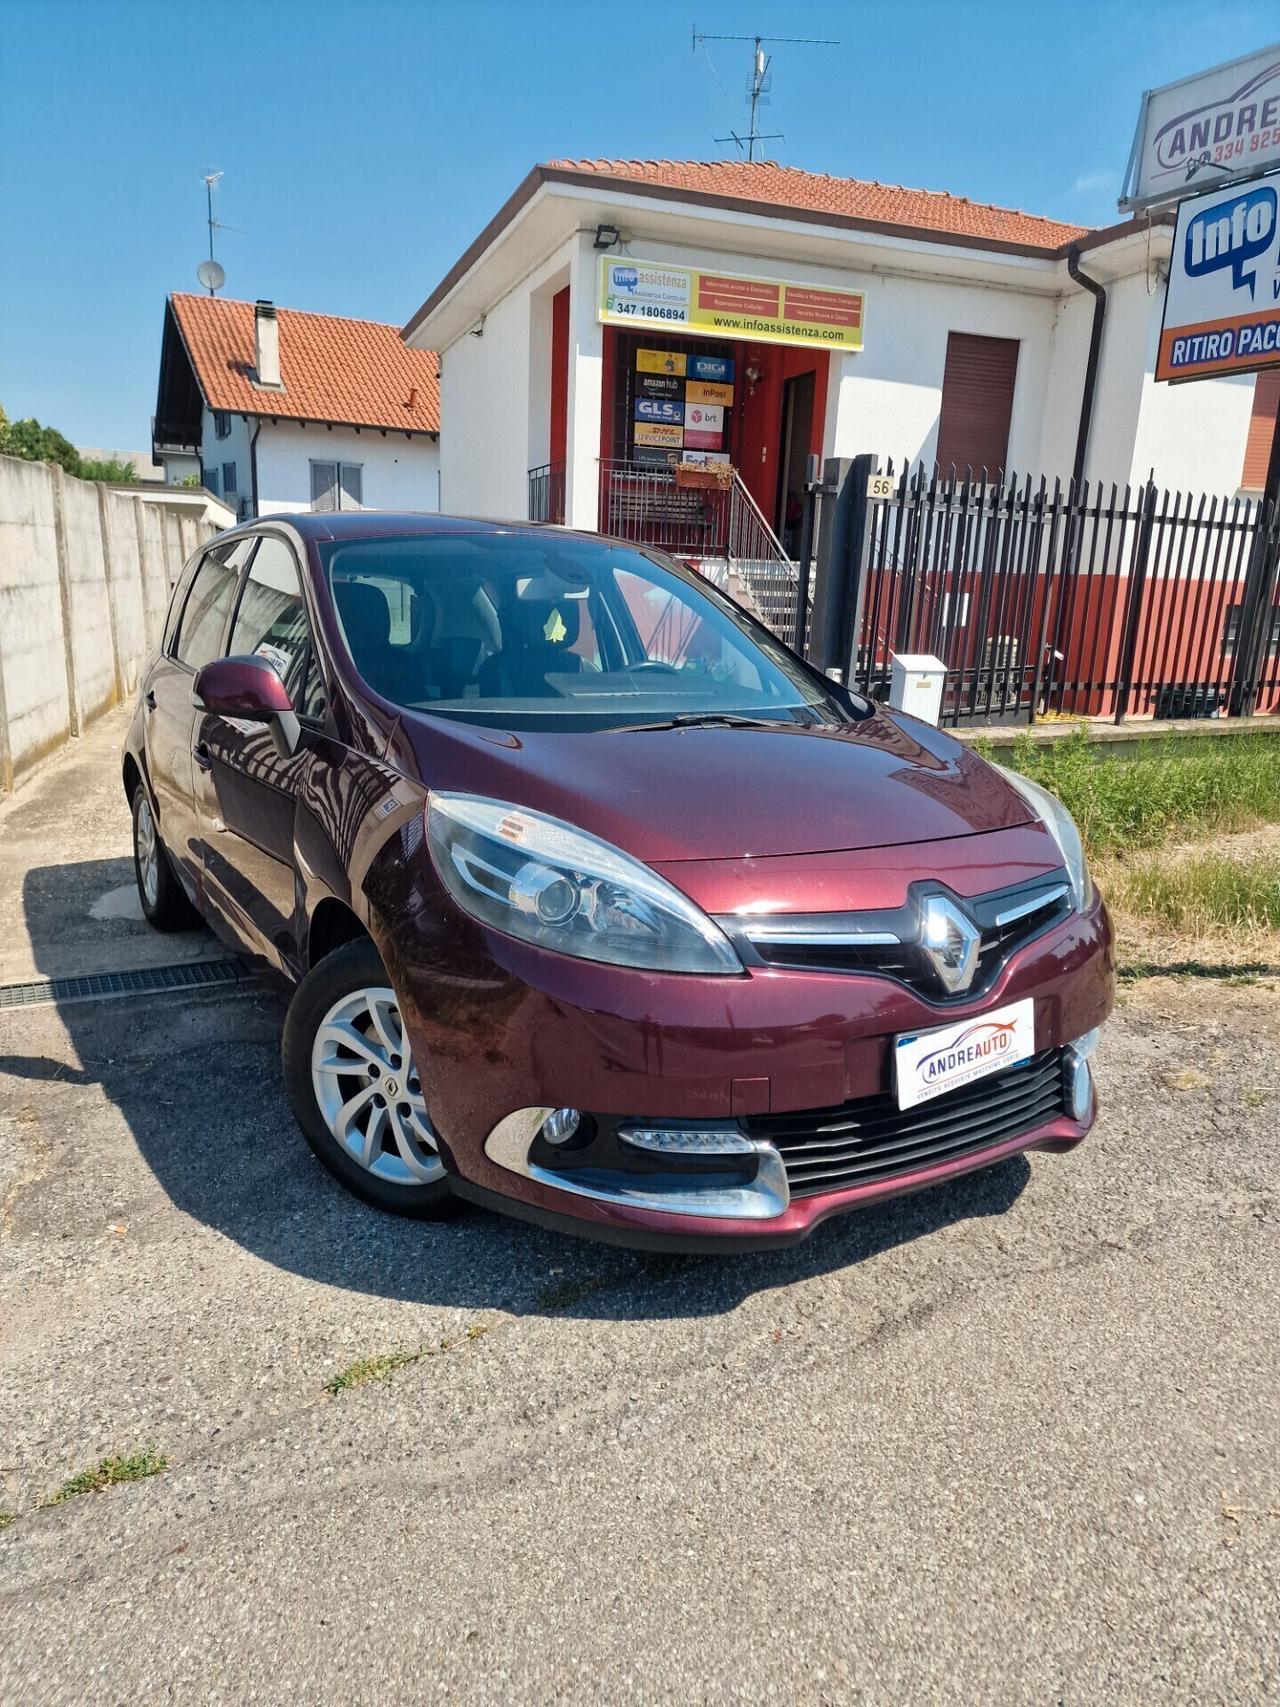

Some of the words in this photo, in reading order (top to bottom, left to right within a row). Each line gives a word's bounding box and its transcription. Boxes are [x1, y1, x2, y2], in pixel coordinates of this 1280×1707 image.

[1168, 95, 1280, 159] ANDRE
[1214, 138, 1244, 163] 334
[1191, 201, 1272, 268] Info
[640, 271, 687, 289] assistenza
[617, 302, 637, 315] 347
[640, 305, 686, 321] 1806894
[713, 317, 844, 340] www.infoassistenza.com
[1172, 332, 1232, 365] RITIRO
[696, 362, 725, 373] DIGI
[643, 378, 666, 389] amazon
[666, 378, 678, 390] hub
[703, 388, 727, 399] InPost
[639, 401, 674, 416] GLS
[705, 413, 718, 423] brt
[651, 427, 676, 436] DHL
[873, 480, 890, 495] 56
[928, 1033, 1007, 1078] ANDREAUTO
